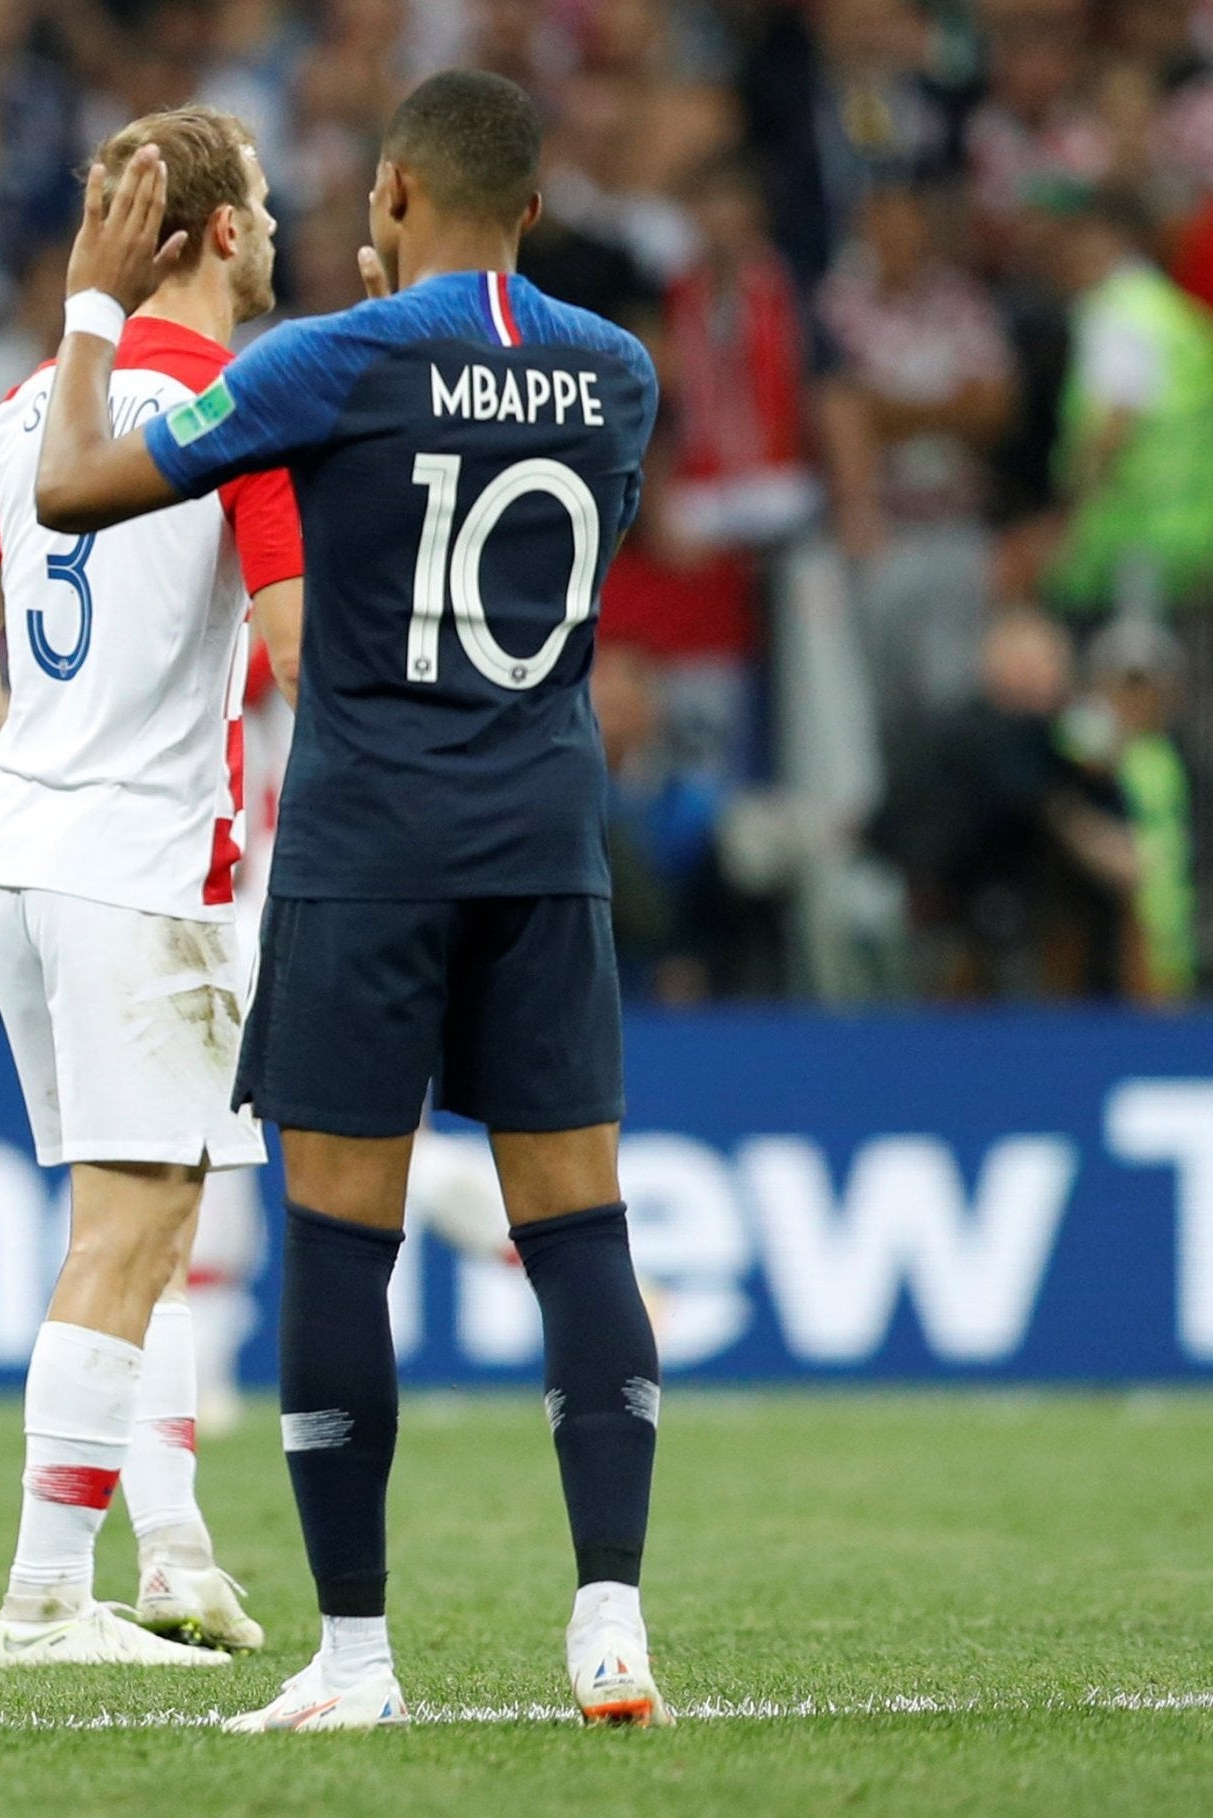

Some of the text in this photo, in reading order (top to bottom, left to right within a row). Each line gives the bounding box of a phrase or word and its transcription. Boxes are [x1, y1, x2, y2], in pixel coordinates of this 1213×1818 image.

[431, 363, 604, 426] MBAPPE
[26, 532, 95, 681] 3
[407, 452, 599, 690] 10
